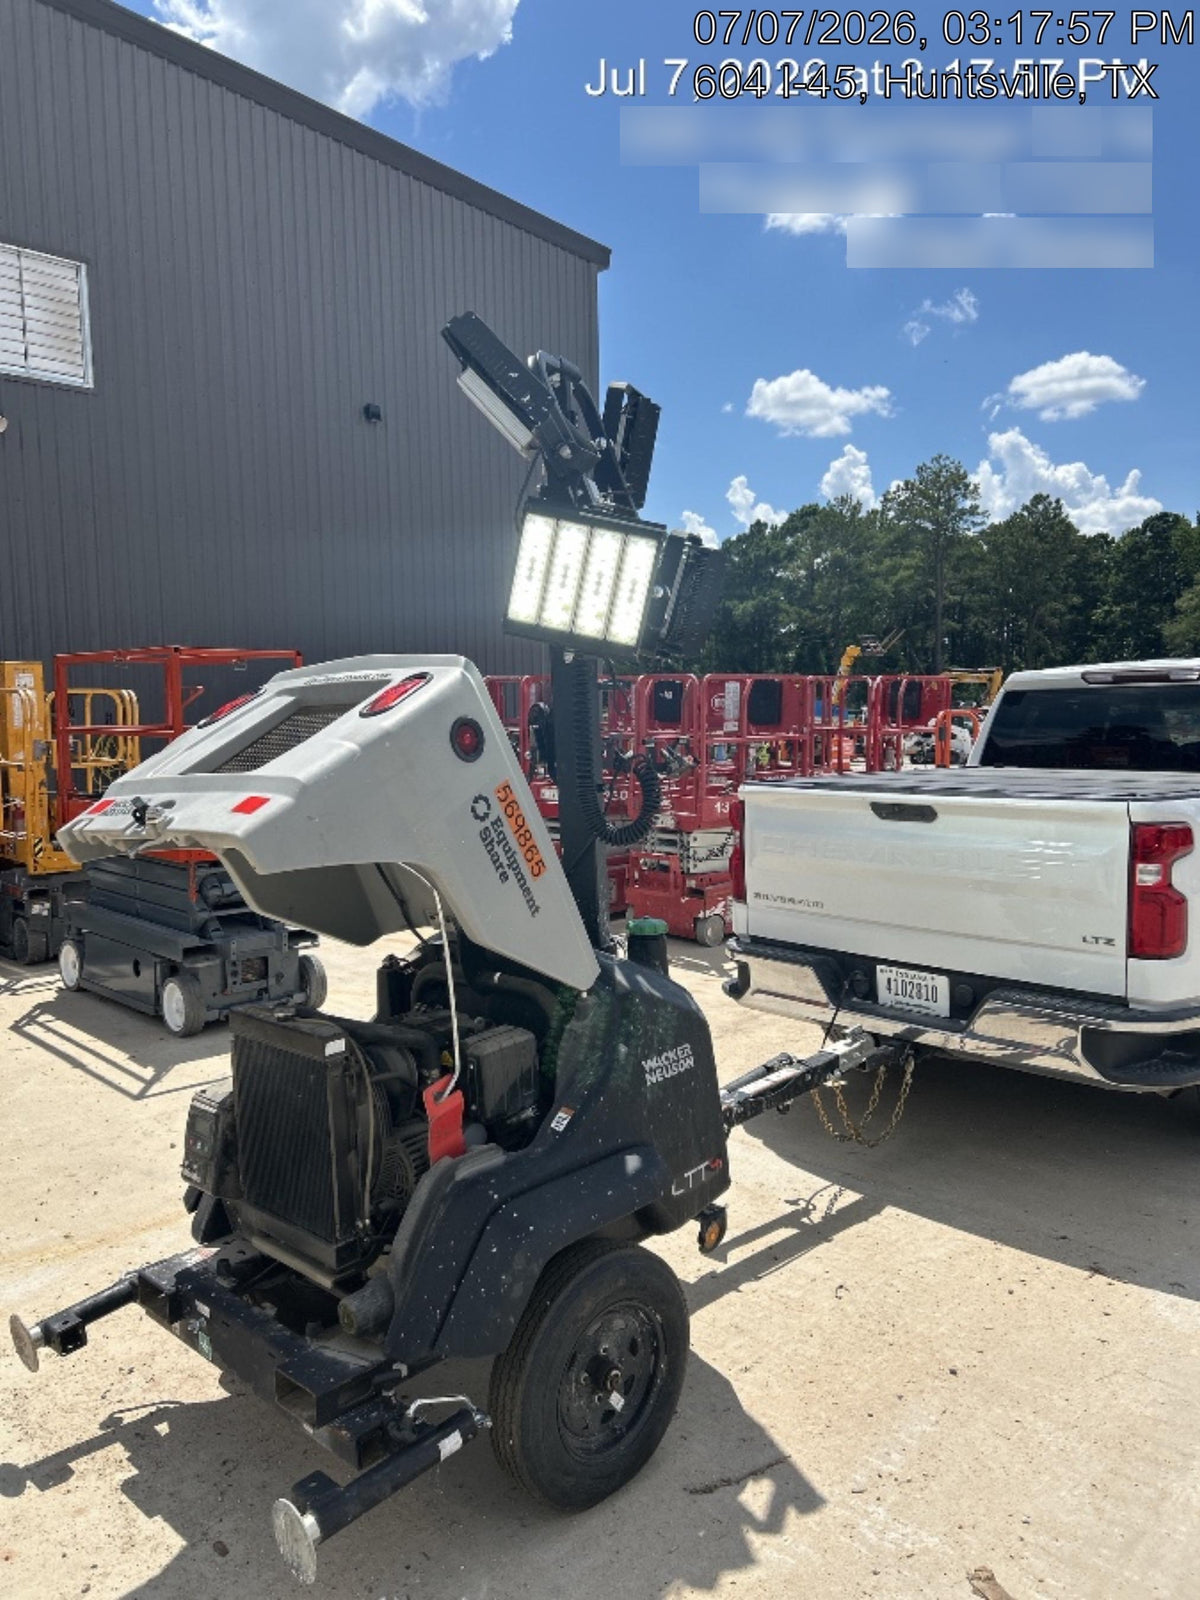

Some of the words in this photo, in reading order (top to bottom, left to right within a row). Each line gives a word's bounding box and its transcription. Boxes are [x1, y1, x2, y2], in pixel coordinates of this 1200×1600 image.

[496, 784, 548, 878] 569865
[479, 825, 510, 885] Share
[489, 815, 542, 919] Equipment
[1081, 935, 1117, 948] LTZ
[641, 1043, 693, 1073] WACKER
[645, 1055, 695, 1088] NEUSON
